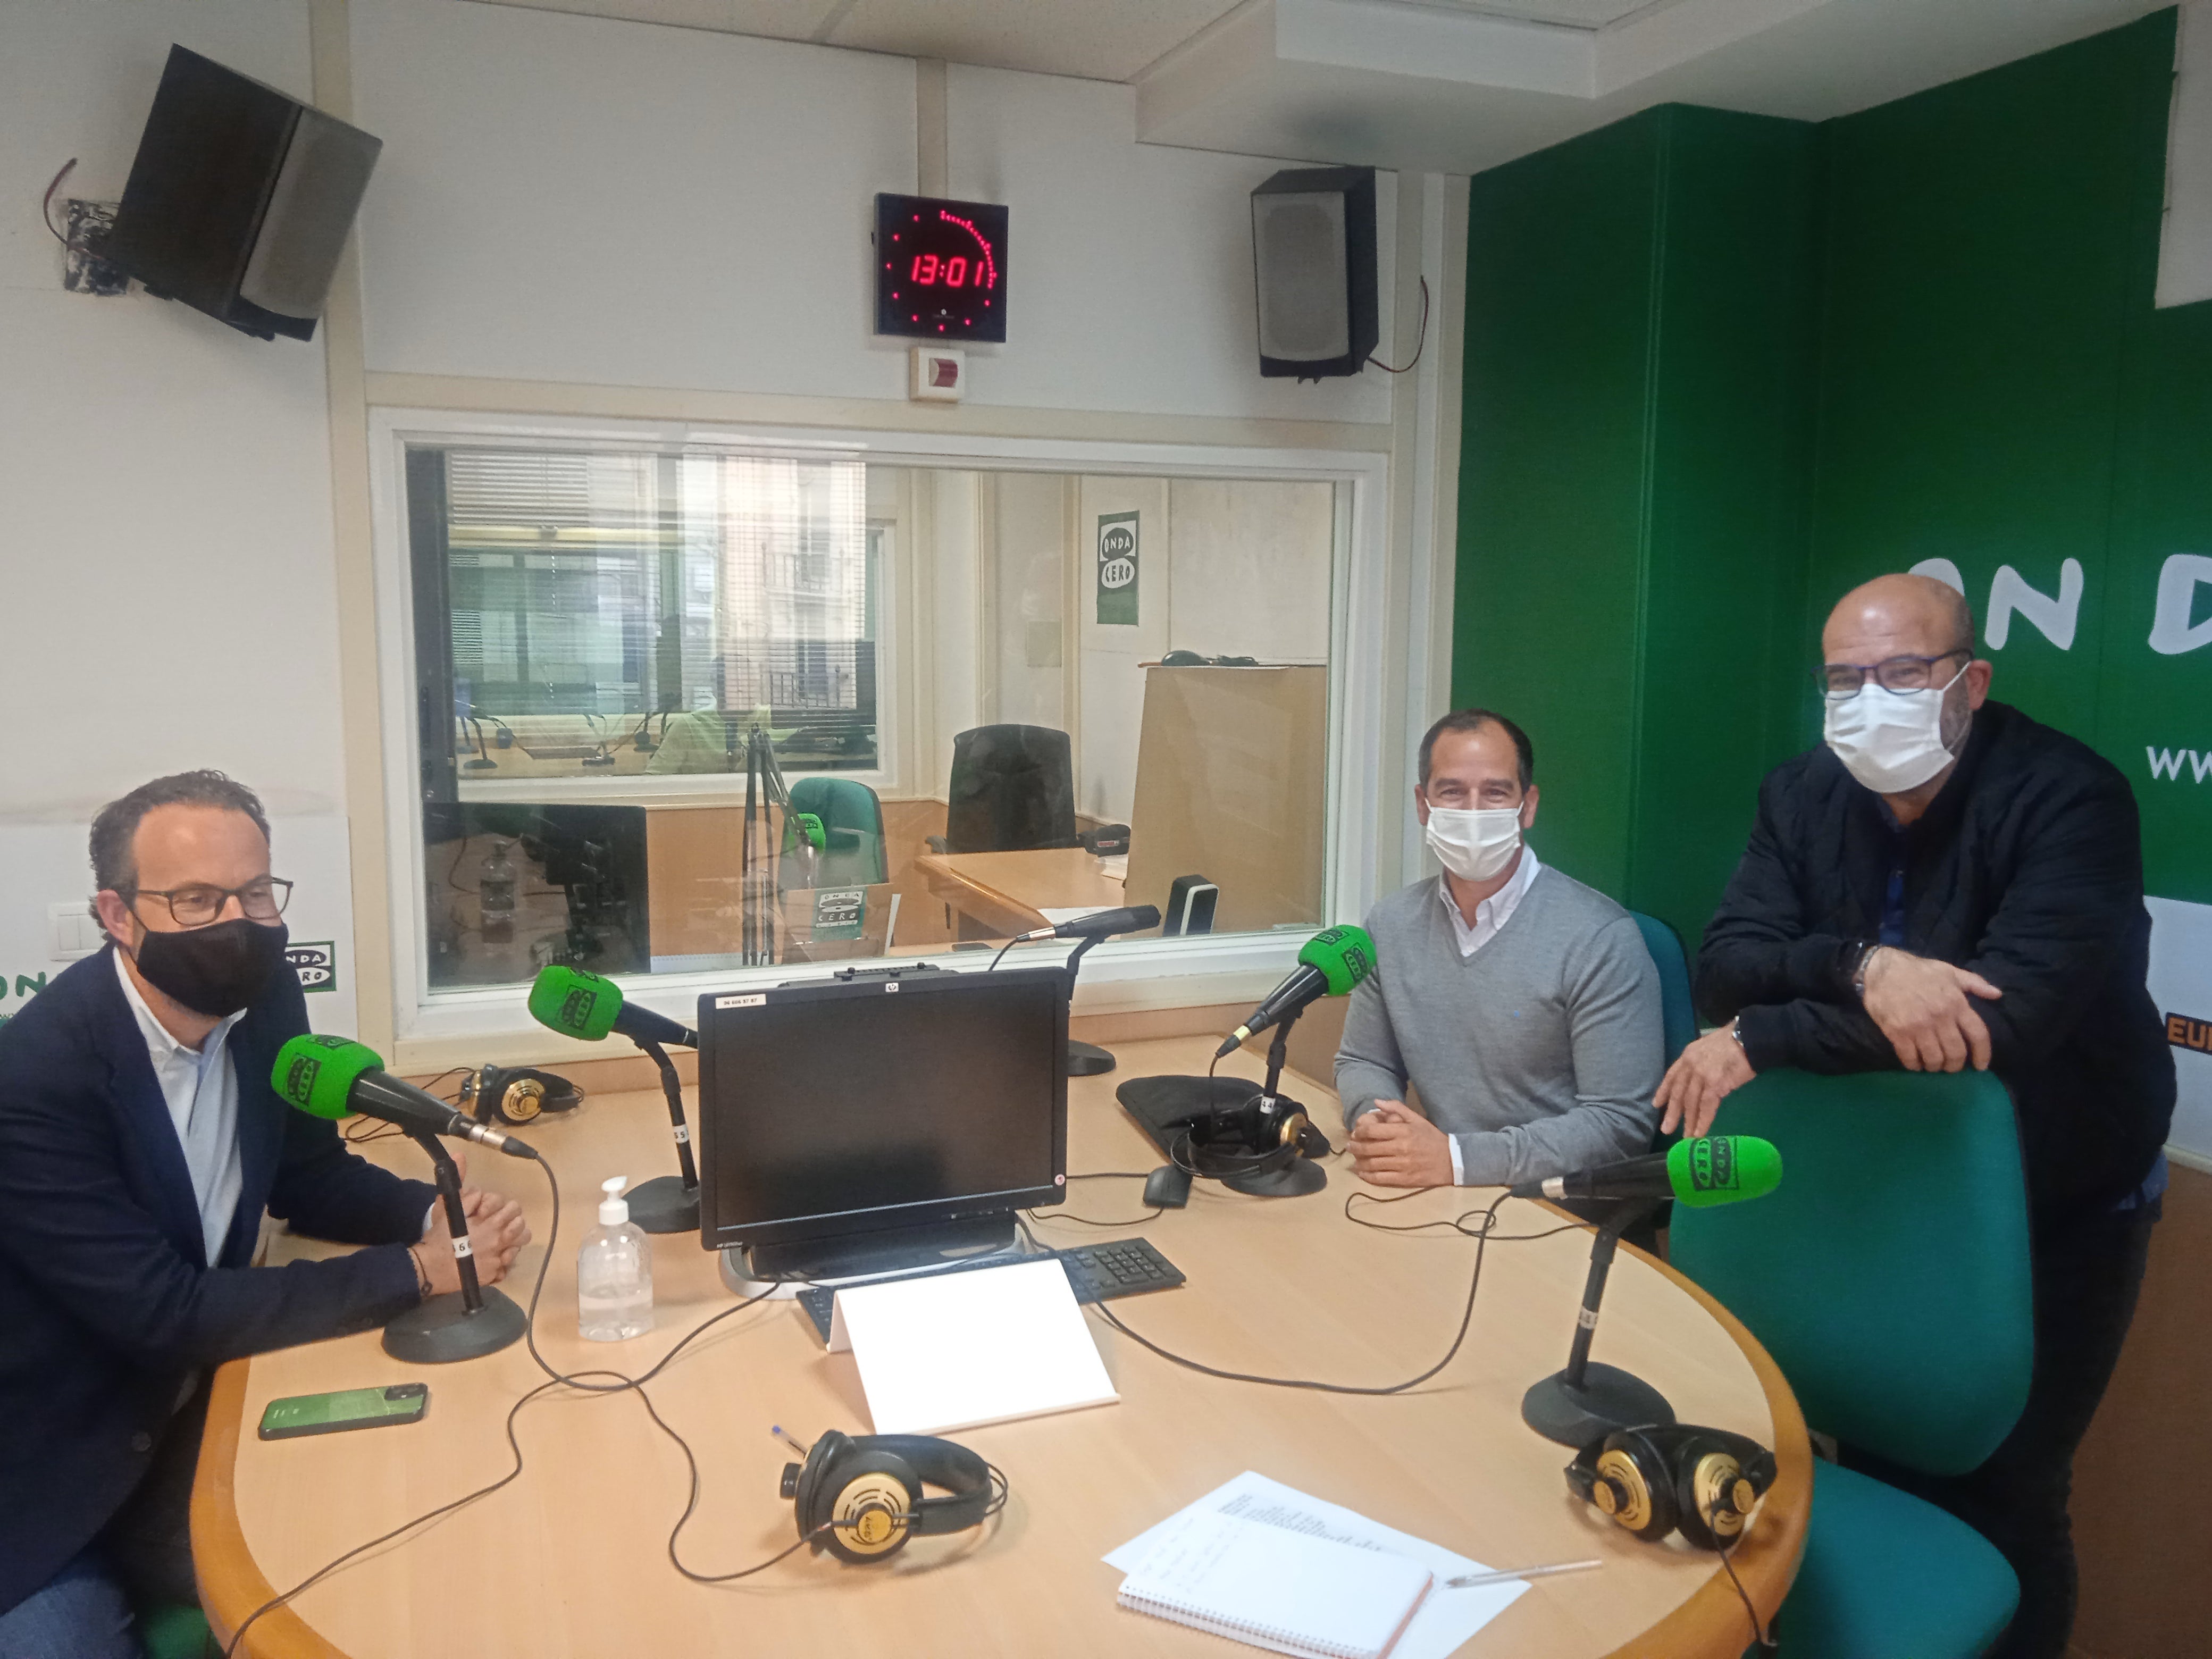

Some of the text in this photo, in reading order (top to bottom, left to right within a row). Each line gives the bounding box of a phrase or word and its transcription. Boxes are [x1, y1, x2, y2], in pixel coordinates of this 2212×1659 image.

[911, 254, 984, 287] 13:01
[1104, 537, 1130, 553] ONDA
[1105, 565, 1130, 582] CERO
[1908, 554, 2212, 655] ND
[818, 912, 856, 921] CERO
[286, 954, 321, 963] NDA
[302, 971, 322, 982] RO
